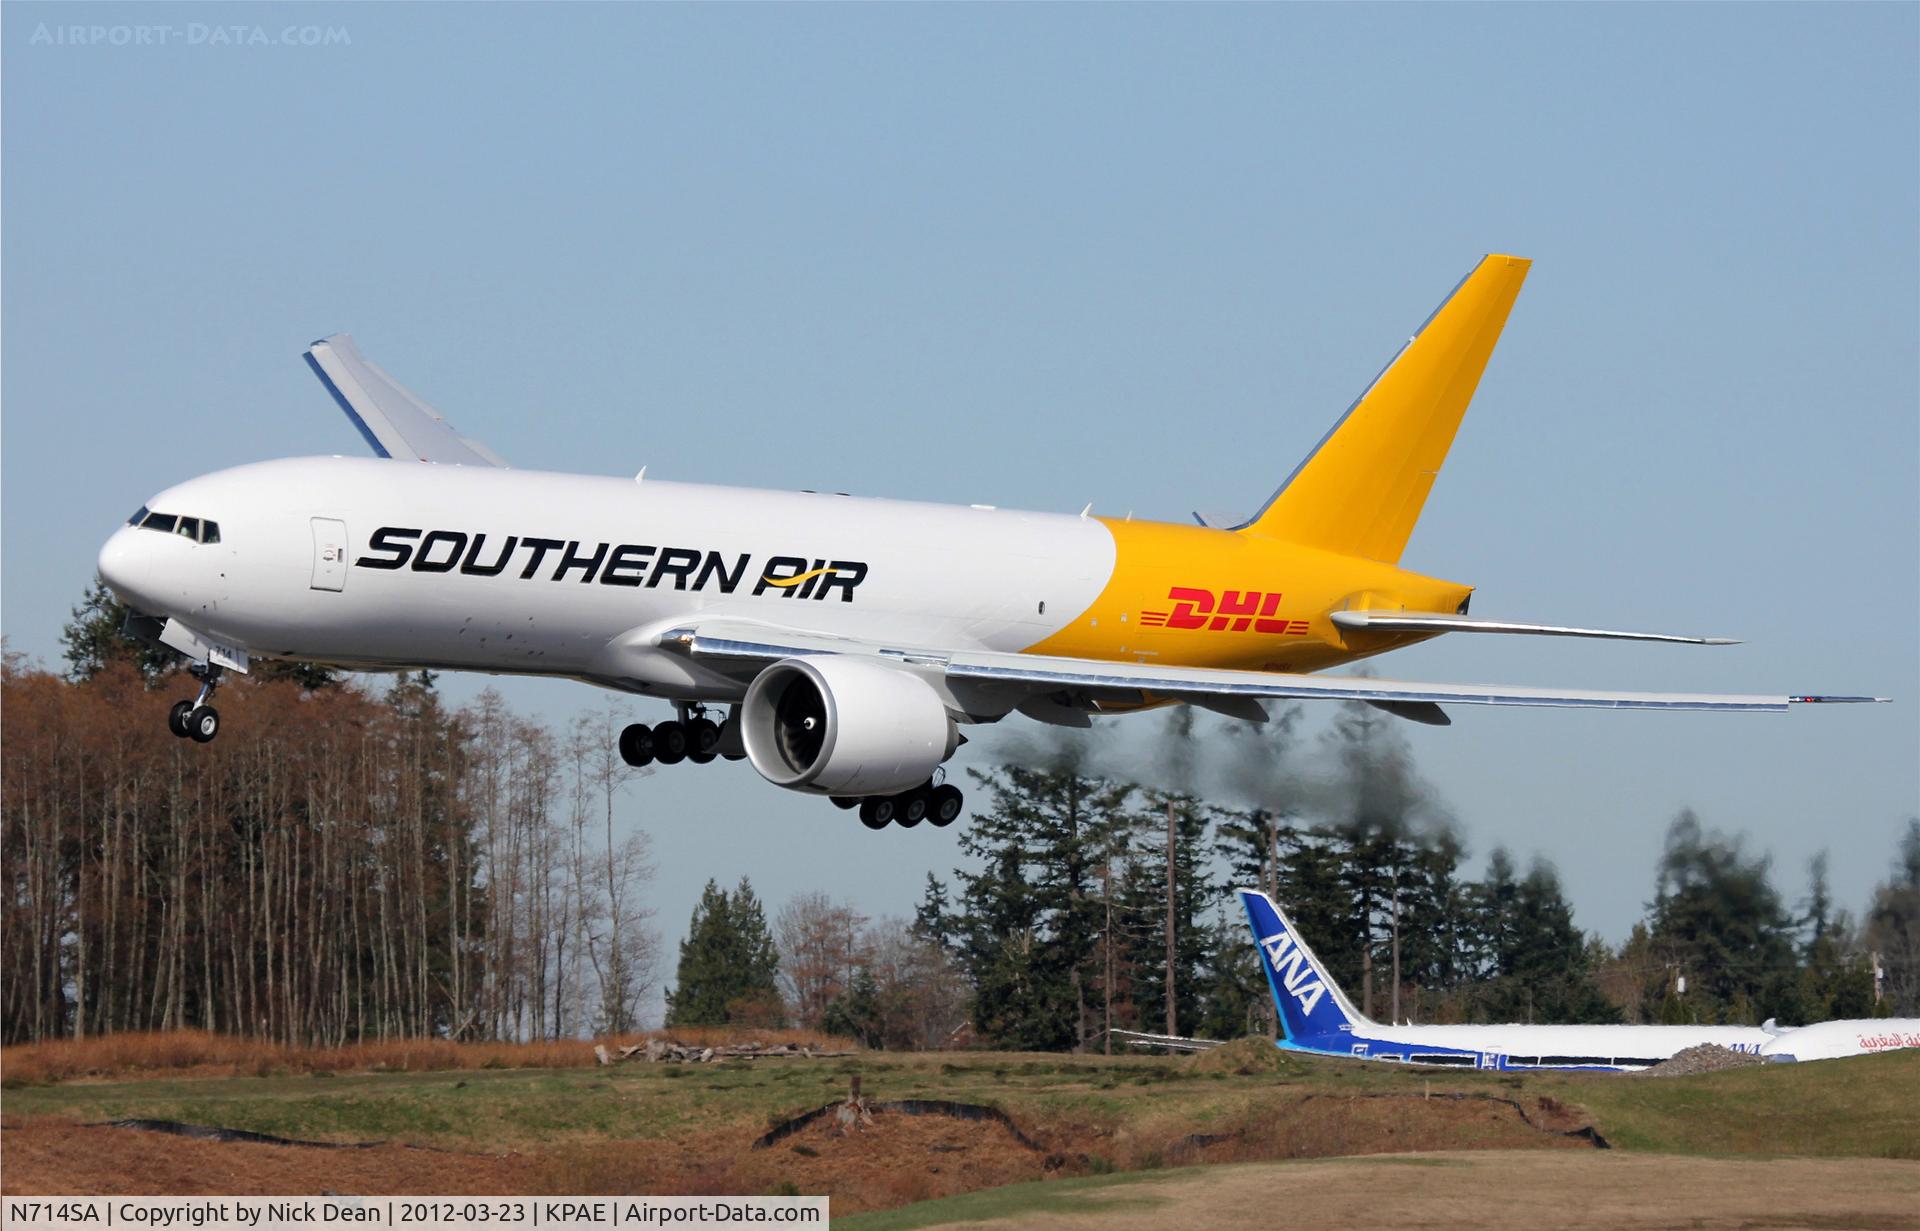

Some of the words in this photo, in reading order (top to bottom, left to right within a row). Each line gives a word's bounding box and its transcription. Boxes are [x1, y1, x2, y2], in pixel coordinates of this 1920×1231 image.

[355, 526, 751, 594] SOUTHERN
[752, 556, 868, 602] AIR
[1165, 586, 1289, 634] DHL
[1260, 931, 1328, 1016] ANA
